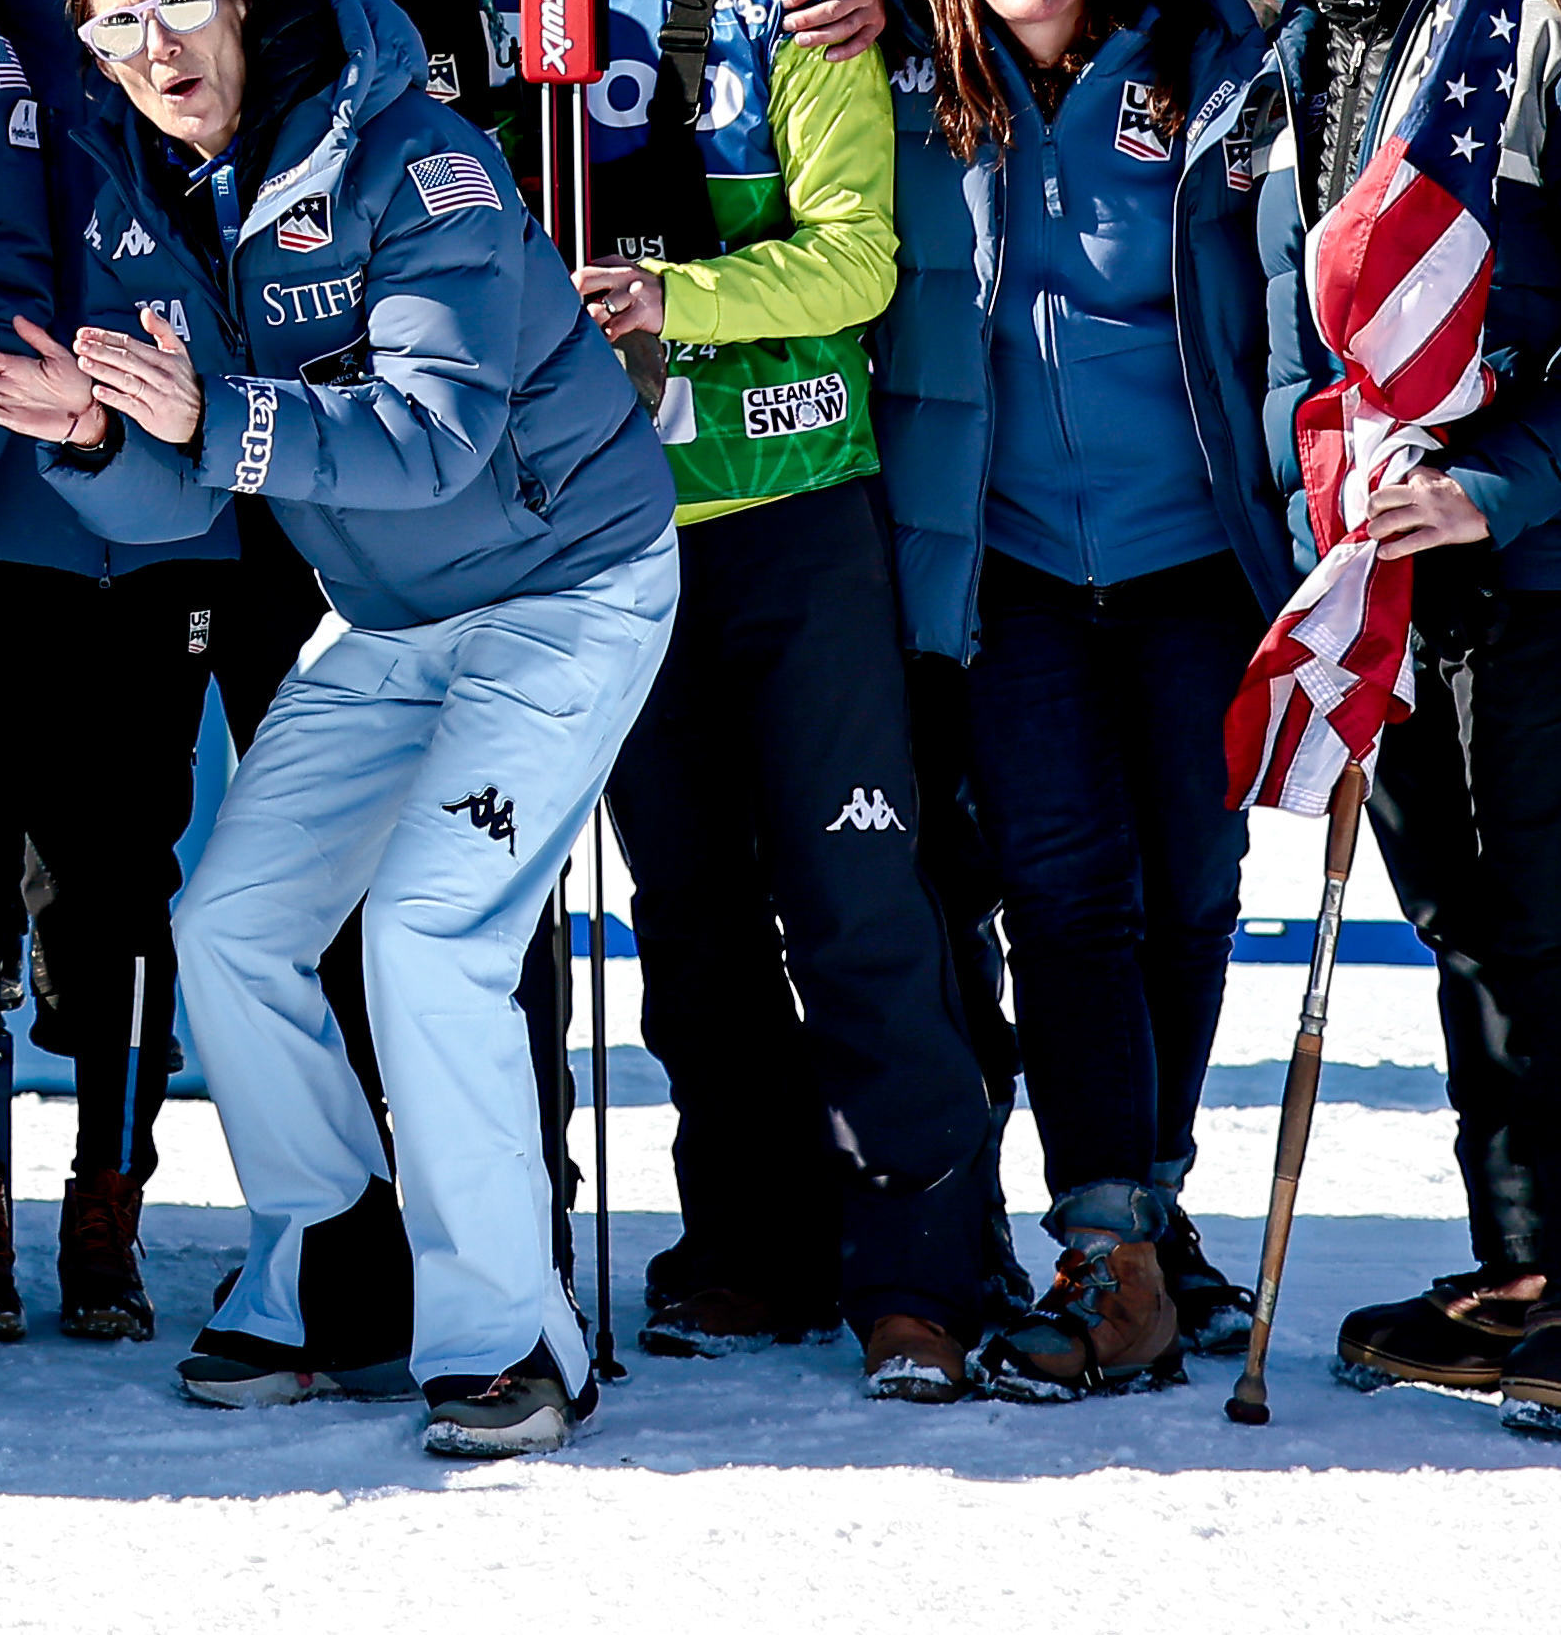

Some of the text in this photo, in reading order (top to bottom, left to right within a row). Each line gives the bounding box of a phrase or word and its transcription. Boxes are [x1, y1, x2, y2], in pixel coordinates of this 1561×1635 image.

[617, 235, 665, 260] US
[746, 377, 838, 409] CLEAN AS
[189, 610, 211, 626] US
